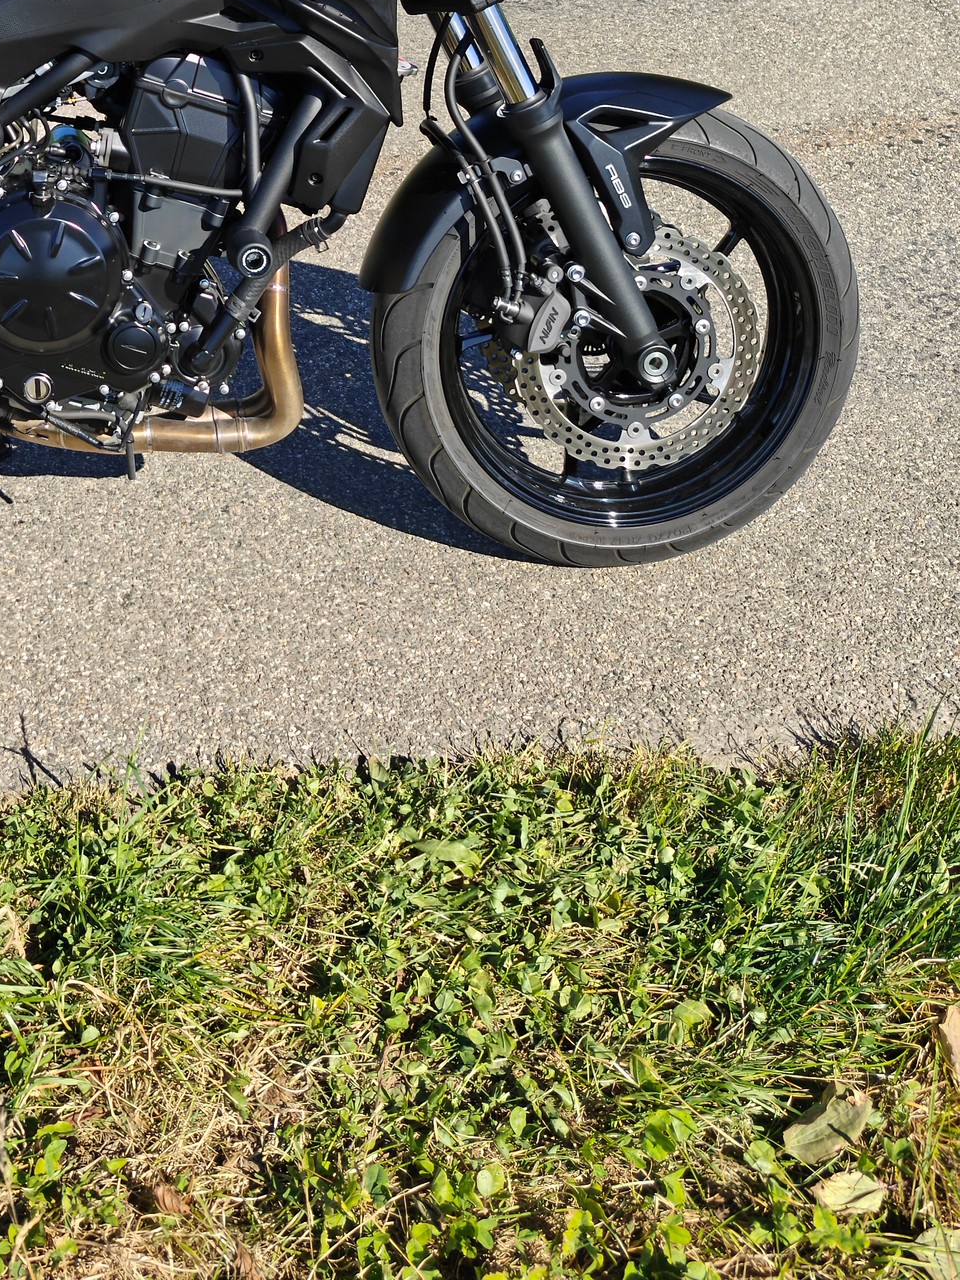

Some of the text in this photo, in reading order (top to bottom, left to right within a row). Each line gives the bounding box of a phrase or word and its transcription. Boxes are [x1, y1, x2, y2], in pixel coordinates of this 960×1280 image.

[682, 145, 711, 158] FRONT
[605, 163, 632, 209] ABS
[779, 205, 839, 336] MICHELIN
[539, 306, 559, 345] NISSIN
